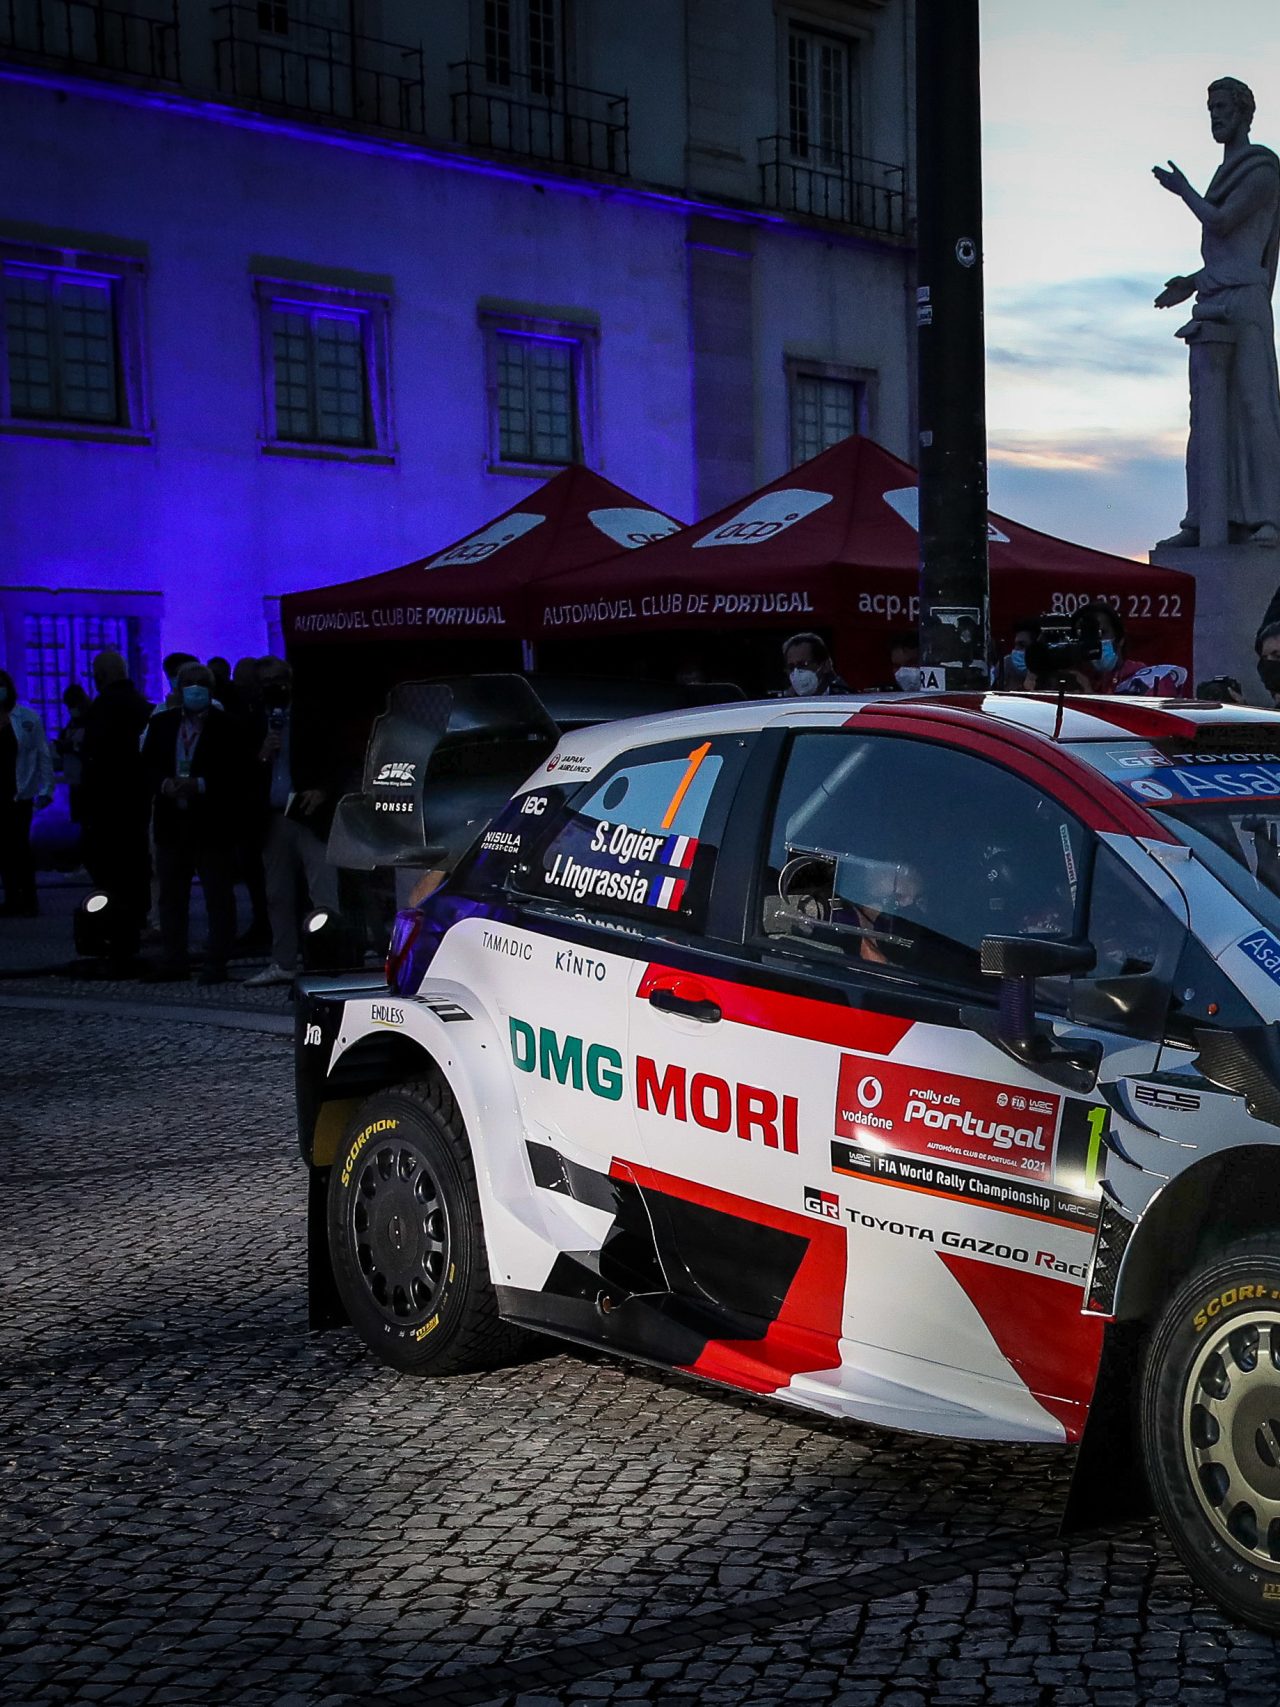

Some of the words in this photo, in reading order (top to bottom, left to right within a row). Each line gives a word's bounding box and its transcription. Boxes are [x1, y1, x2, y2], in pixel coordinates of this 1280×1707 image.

[714, 521, 783, 540] acp
[543, 597, 637, 626] AUTOMÓVEL
[641, 593, 683, 616] CLUB
[687, 594, 709, 613] DE
[712, 591, 814, 613] PORTUGAL
[1128, 594, 1151, 617] 22
[1159, 595, 1182, 617] 22
[294, 608, 369, 632] AUTOMÓVEL
[372, 608, 404, 627] CLUB
[407, 607, 423, 625] DE
[426, 606, 506, 625] PORTUGAL
[378, 763, 416, 782] SWS
[558, 764, 592, 773] AIRLINES
[561, 756, 585, 764] JAPAN
[661, 742, 712, 830] 1
[375, 802, 414, 812] PONSSE
[484, 832, 521, 847] NISULA
[590, 820, 664, 864] S.Ogier
[545, 854, 649, 905] J.Ingrassia
[483, 931, 533, 960] TAMADIC
[371, 1005, 404, 1024] ENDLESS
[509, 1015, 624, 1101] DMG
[636, 1055, 799, 1155] MORI
[909, 1089, 941, 1105] rally
[943, 1094, 961, 1106] de
[842, 1109, 893, 1131] vodafone
[904, 1100, 1046, 1151] Portugal
[341, 1119, 397, 1187] SCORPION
[927, 1142, 962, 1155] AUTOMÓVEL
[963, 1149, 978, 1159] CLUB
[979, 1152, 987, 1161] DE
[987, 1154, 1018, 1168] PORTUGAL
[1087, 1107, 1106, 1190] 1
[1020, 1157, 1046, 1173] 2021
[878, 1158, 897, 1174] FIA
[899, 1161, 933, 1182] World
[936, 1171, 966, 1192] Rally
[968, 1178, 1051, 1210] Championship
[805, 1196, 839, 1219] GR
[845, 1208, 935, 1242] TOYOTA
[941, 1231, 1029, 1263] GAZOO
[1035, 1250, 1089, 1279] Raci
